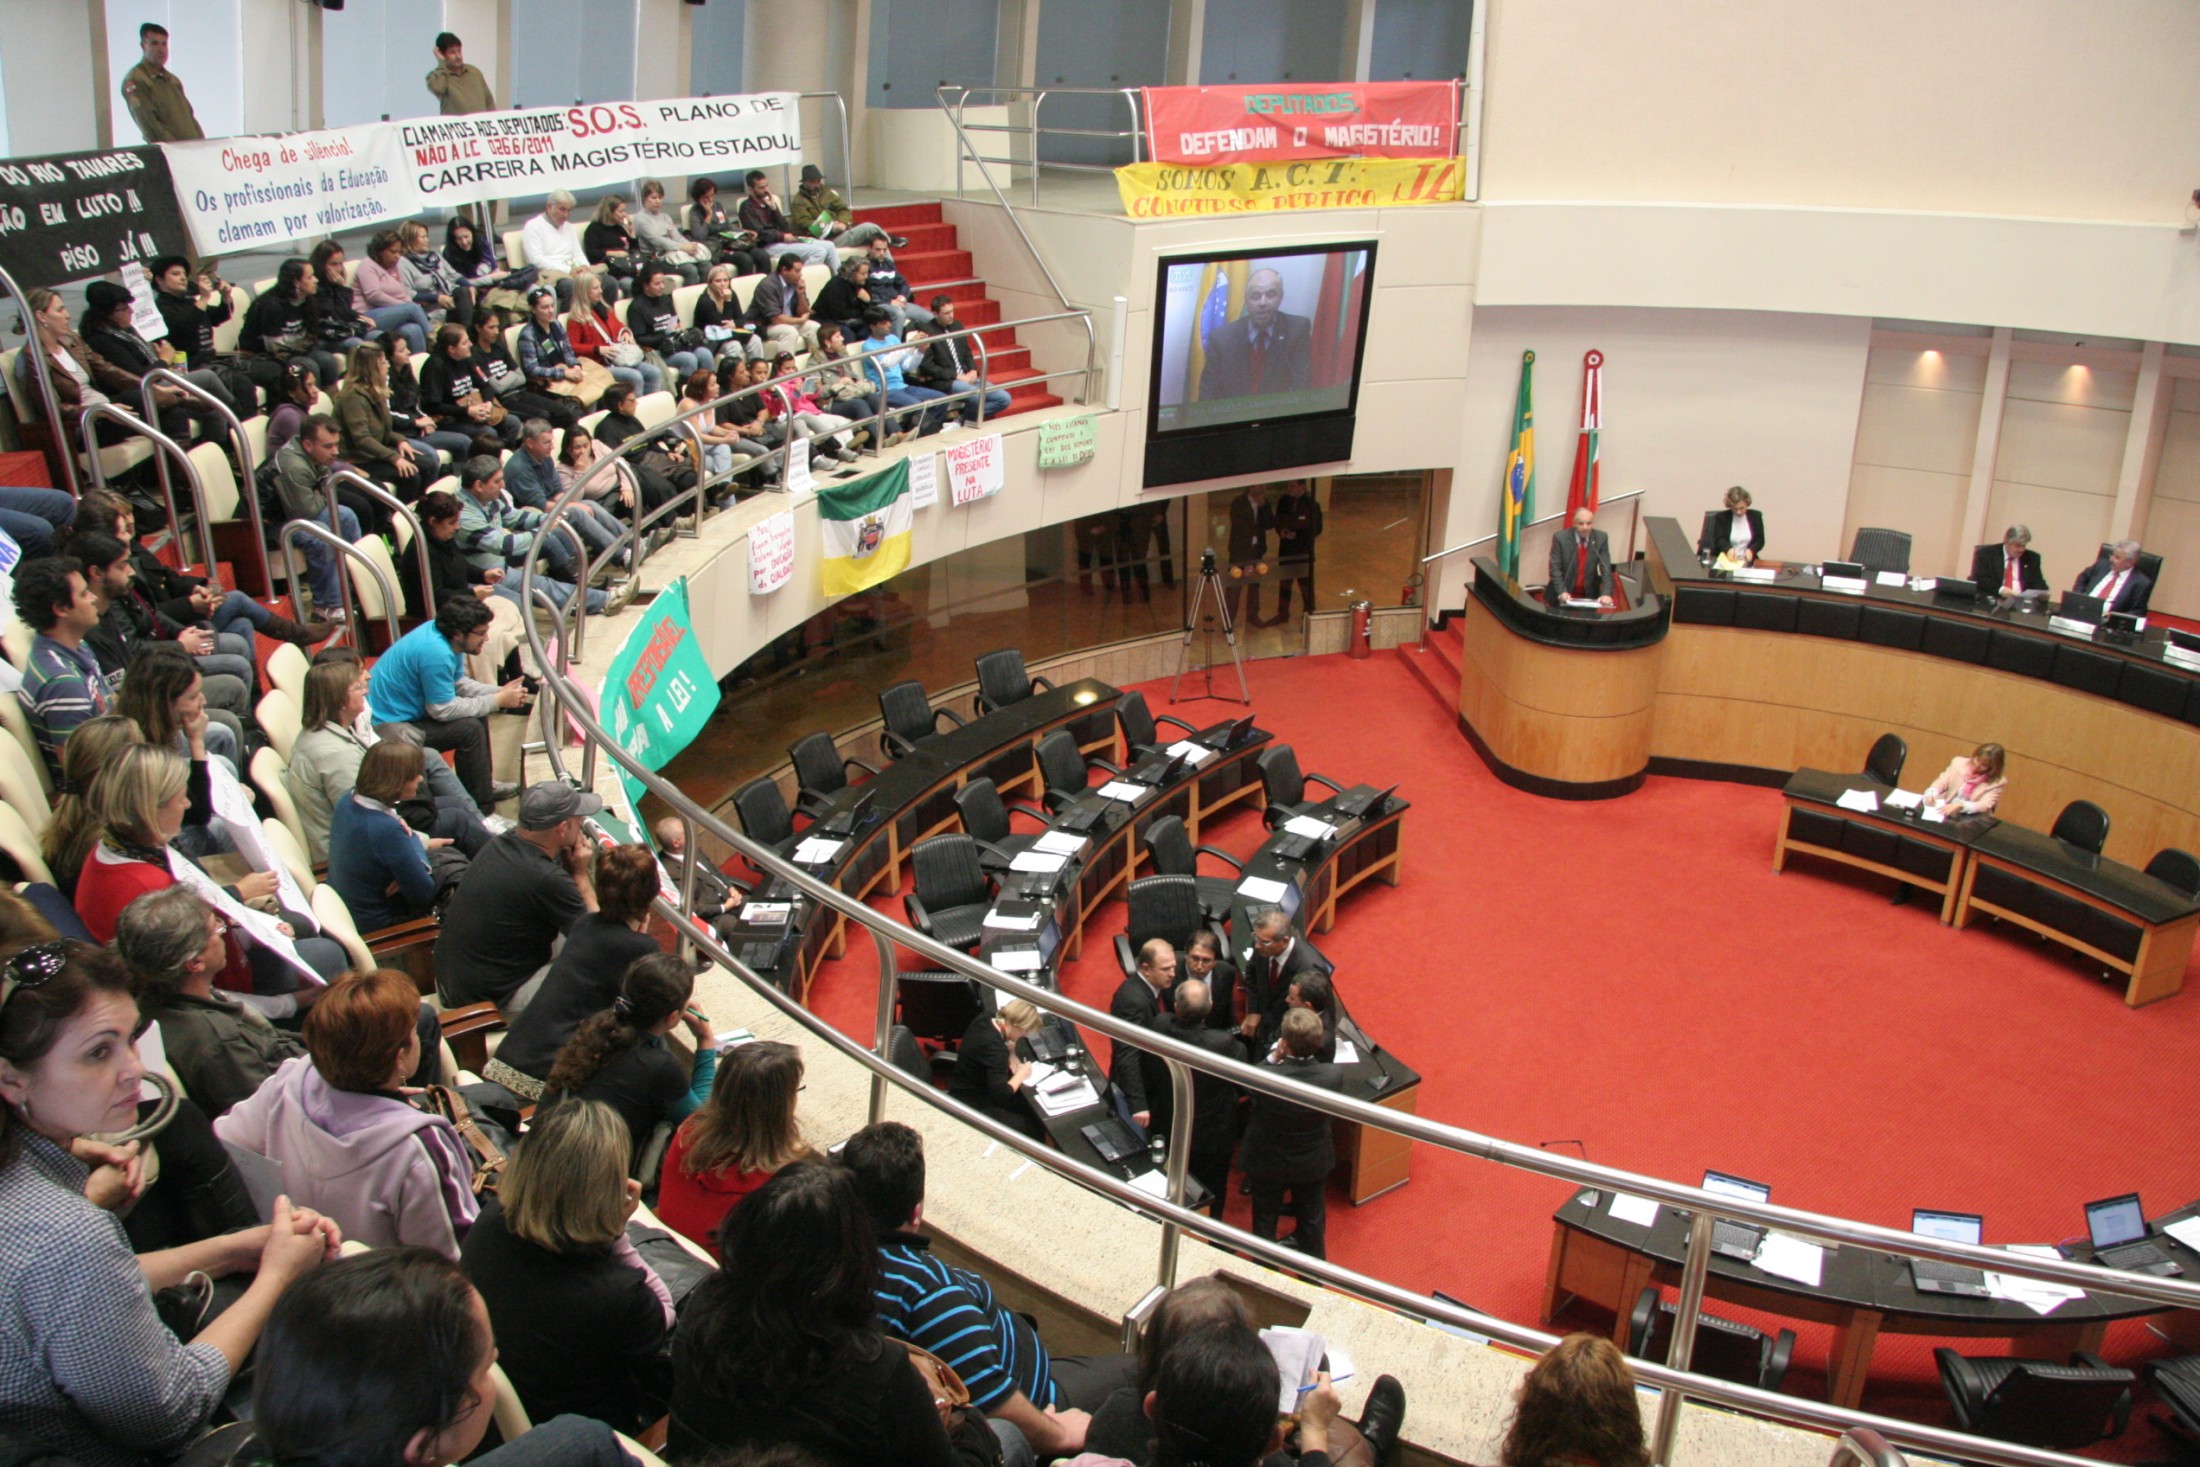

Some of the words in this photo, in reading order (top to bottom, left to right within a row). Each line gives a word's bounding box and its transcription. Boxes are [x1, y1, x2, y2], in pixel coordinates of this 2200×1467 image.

[403, 121, 475, 147] CLAMAMOS
[474, 120, 499, 138] AOS
[567, 104, 648, 138] S.O.S.
[659, 103, 740, 122] PLANO
[750, 98, 784, 113] DE
[1180, 127, 1277, 155] DEFENDAM
[1293, 127, 1307, 148] O
[1325, 118, 1440, 149] MAGISTÉRIO!
[26, 161, 66, 184] RIO
[64, 152, 145, 180] TAVARES
[221, 148, 271, 172] Chega
[280, 144, 298, 164] de
[304, 137, 354, 161] silêncio!
[415, 144, 447, 167] NÃO
[463, 139, 481, 158] LC
[418, 158, 544, 193] CARREIRA
[550, 136, 694, 172] MAGISTÉRIO
[195, 190, 218, 212] Os
[223, 177, 314, 214] profissionais
[321, 172, 335, 192] da
[339, 166, 389, 190] Educação
[1156, 168, 1236, 191] SOMOS
[39, 202, 68, 226] EM
[76, 192, 124, 219] LUTO
[218, 220, 277, 244] clamam
[284, 213, 308, 236] por
[317, 197, 387, 225] valorização.
[120, 230, 140, 261] JÁ
[947, 438, 993, 461] MAGISTÉRIO
[955, 455, 991, 476] PRESENTE
[957, 485, 984, 502] LUTA
